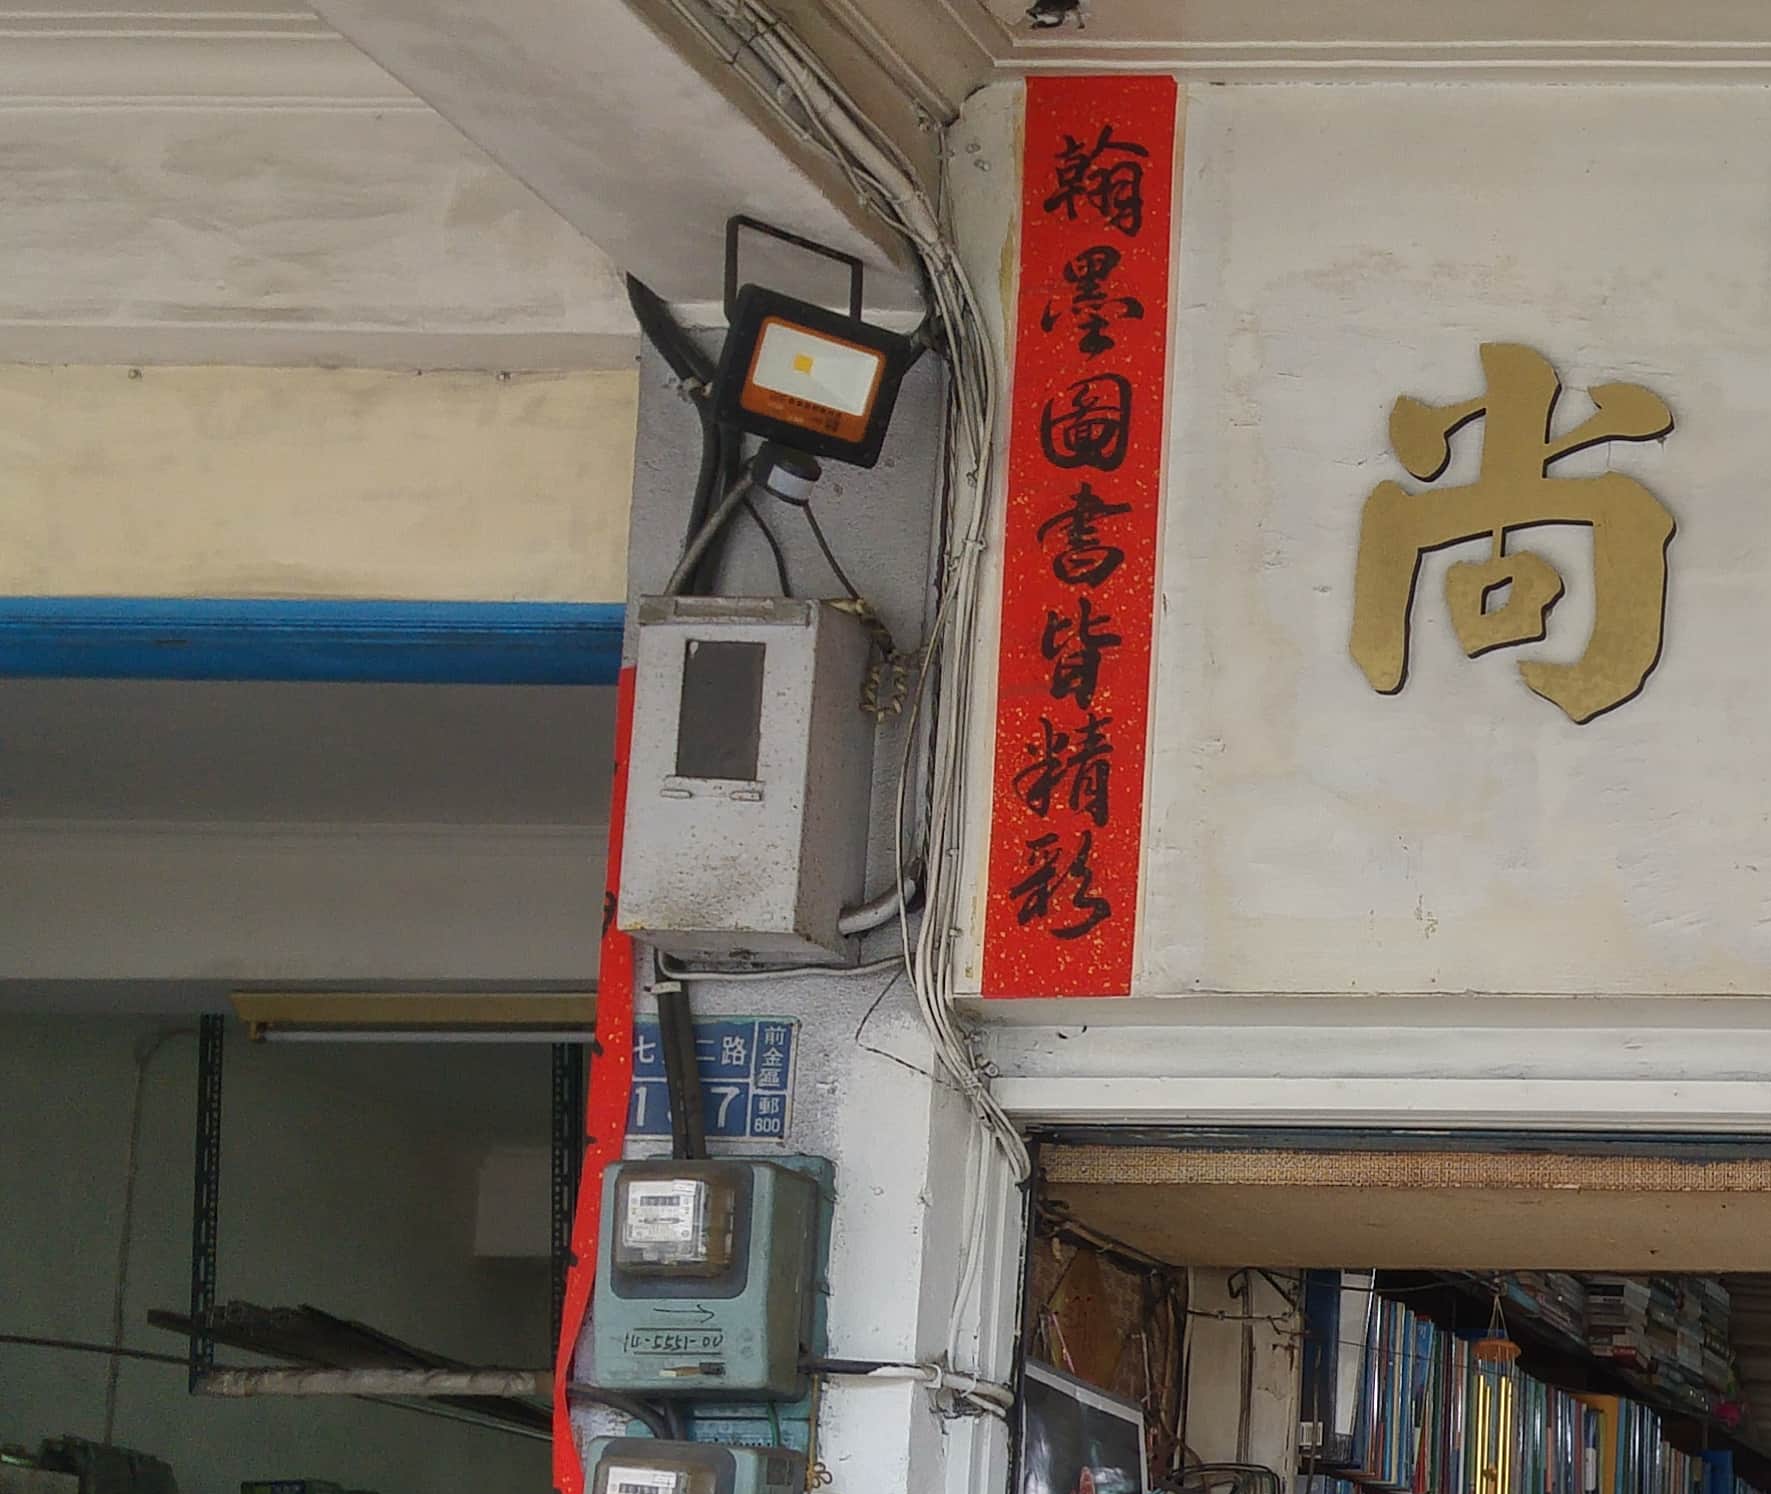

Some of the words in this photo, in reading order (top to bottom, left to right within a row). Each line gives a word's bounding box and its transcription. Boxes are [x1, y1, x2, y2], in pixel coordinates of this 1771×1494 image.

[633, 1035, 746, 1066] 七二路
[634, 1086, 741, 1128] 17
